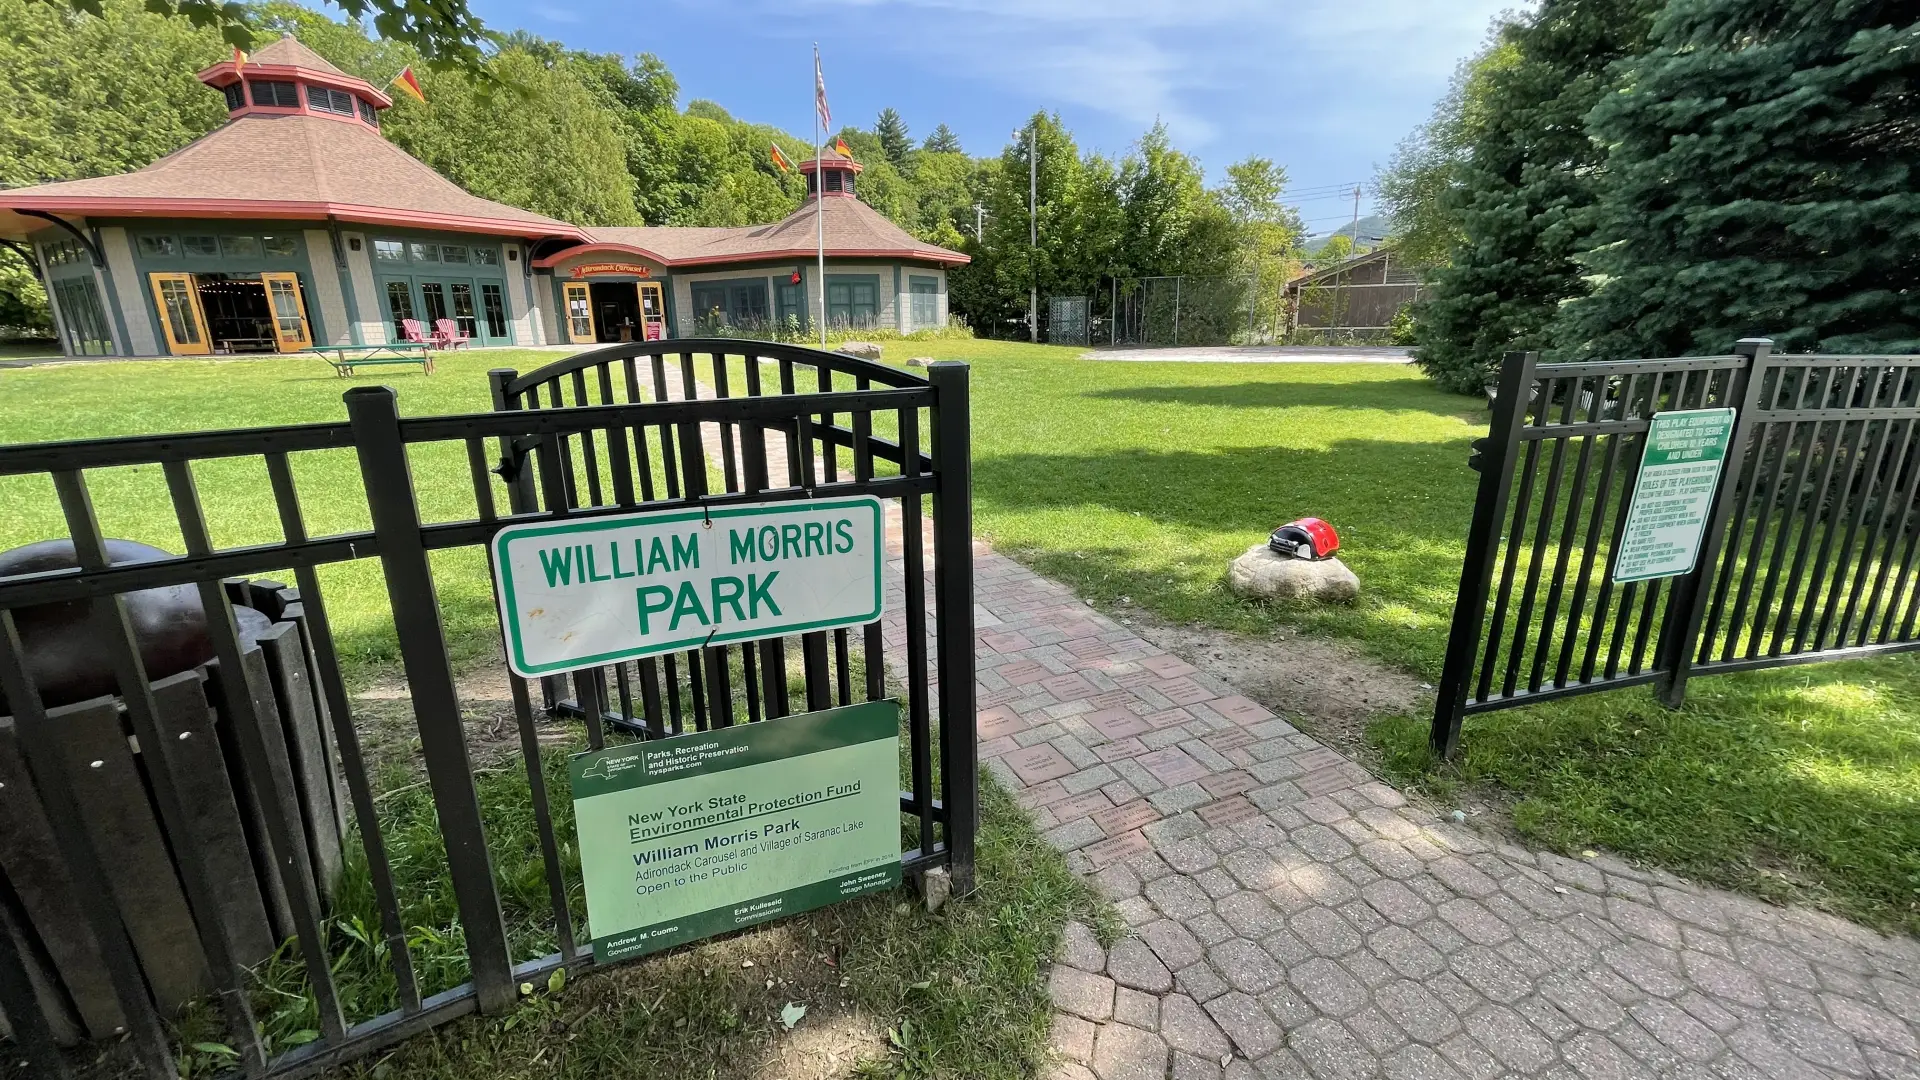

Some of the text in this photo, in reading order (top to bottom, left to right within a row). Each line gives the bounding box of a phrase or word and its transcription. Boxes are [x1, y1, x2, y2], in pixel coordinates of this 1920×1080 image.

[1656, 419, 1670, 428] THIS
[1671, 418, 1687, 426] PLAY
[1688, 415, 1722, 425] EQUIPMENT
[1656, 426, 1724, 439] DESIGNATED TO SERVE
[1657, 439, 1688, 450] CHILDREN
[1699, 437, 1717, 446] YEARS
[1666, 449, 1702, 460] AND UNDER
[1641, 474, 1712, 489] RULES OF THE PLAYGROUND
[538, 518, 854, 588] WILLIAM MORRIS
[636, 571, 782, 636] PARK
[618, 755, 639, 764] YORK
[647, 741, 719, 760] Parks, Recreation
[648, 744, 749, 769] and Historic Preservation
[649, 762, 702, 776] nysparks.com
[628, 794, 746, 826] New York State
[630, 780, 860, 840] Environmental Protection Fund
[633, 819, 800, 866] William Morris Park
[636, 820, 864, 882] Adirondack Carousel and Village of Saranac Lake
[636, 863, 748, 895] Open to the Public
[840, 871, 887, 888] John Sweeney
[840, 877, 892, 895] Village Manager
[734, 898, 782, 916] Erik Kulleseid
[735, 906, 782, 923] Commissioner
[607, 936, 638, 949] Andrew
[651, 926, 679, 938] Cuomo
[607, 943, 642, 957] Governor
